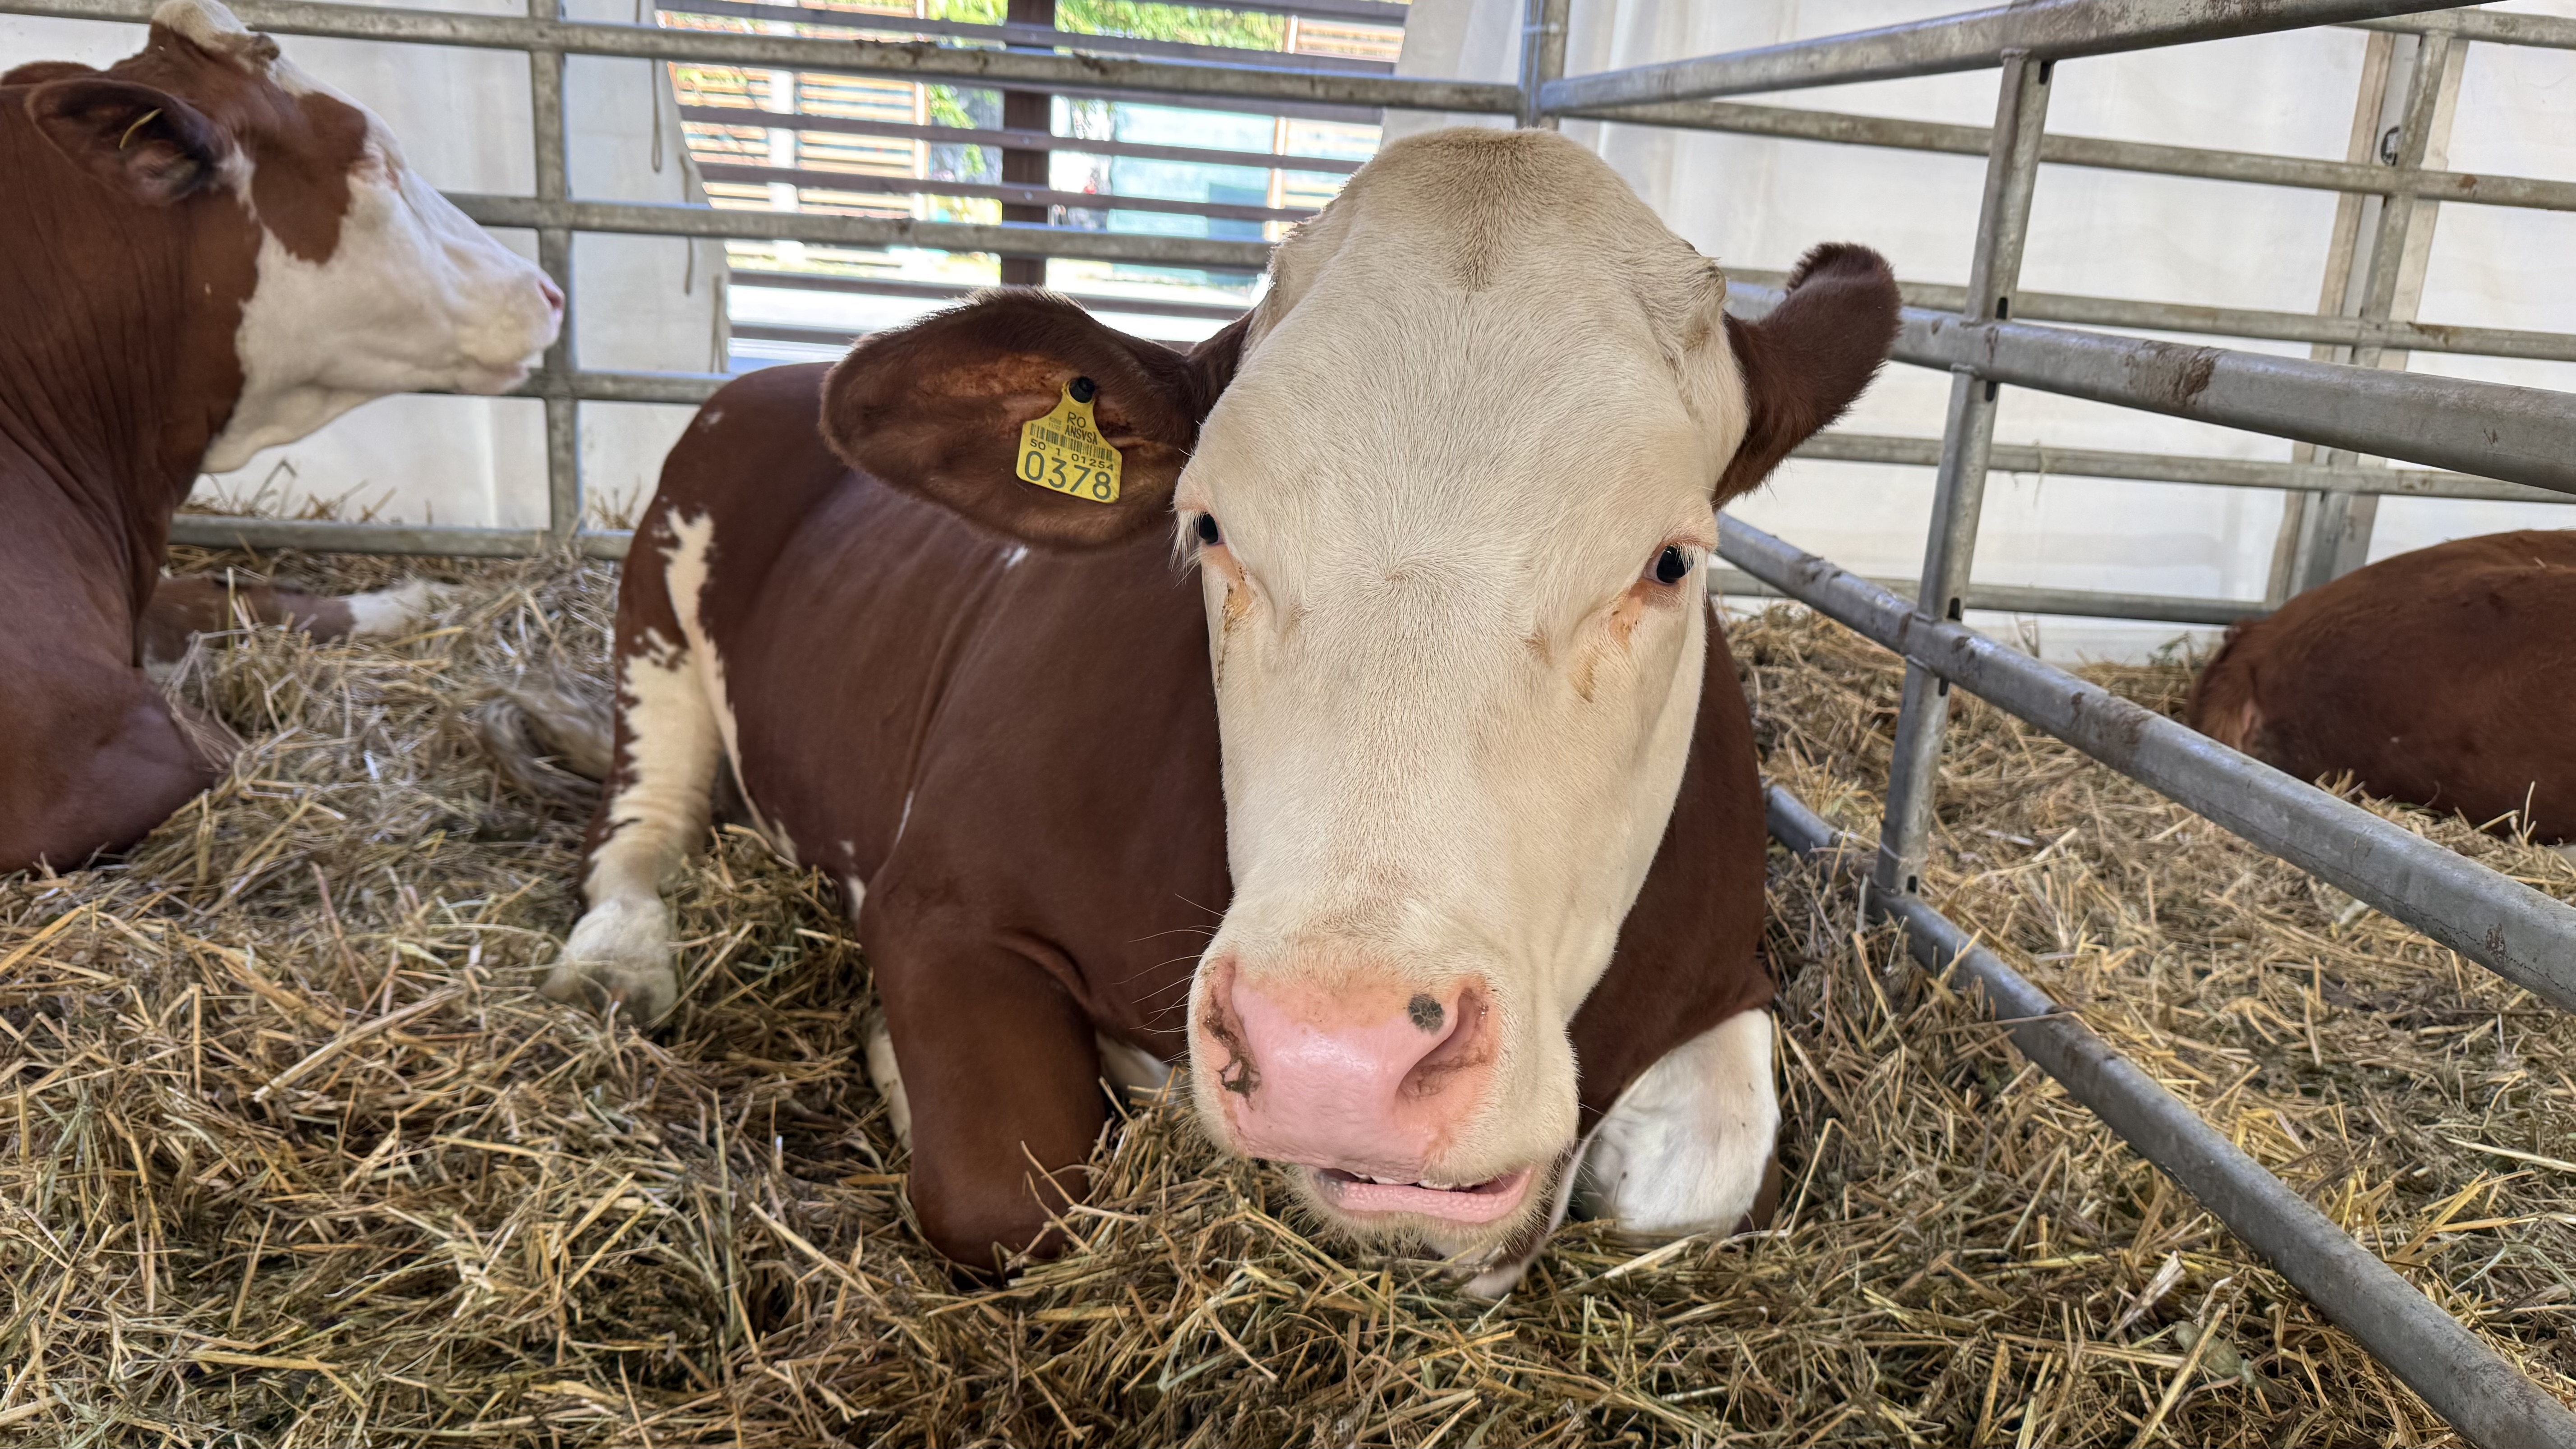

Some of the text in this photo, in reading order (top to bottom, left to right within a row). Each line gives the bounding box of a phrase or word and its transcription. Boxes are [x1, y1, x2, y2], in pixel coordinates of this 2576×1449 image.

[1067, 411, 1086, 428] RO
[1065, 425, 1098, 445] ANSVSA
[1030, 439, 1046, 450] 50
[1071, 453, 1114, 471] 01254
[1025, 451, 1111, 500] 0378
